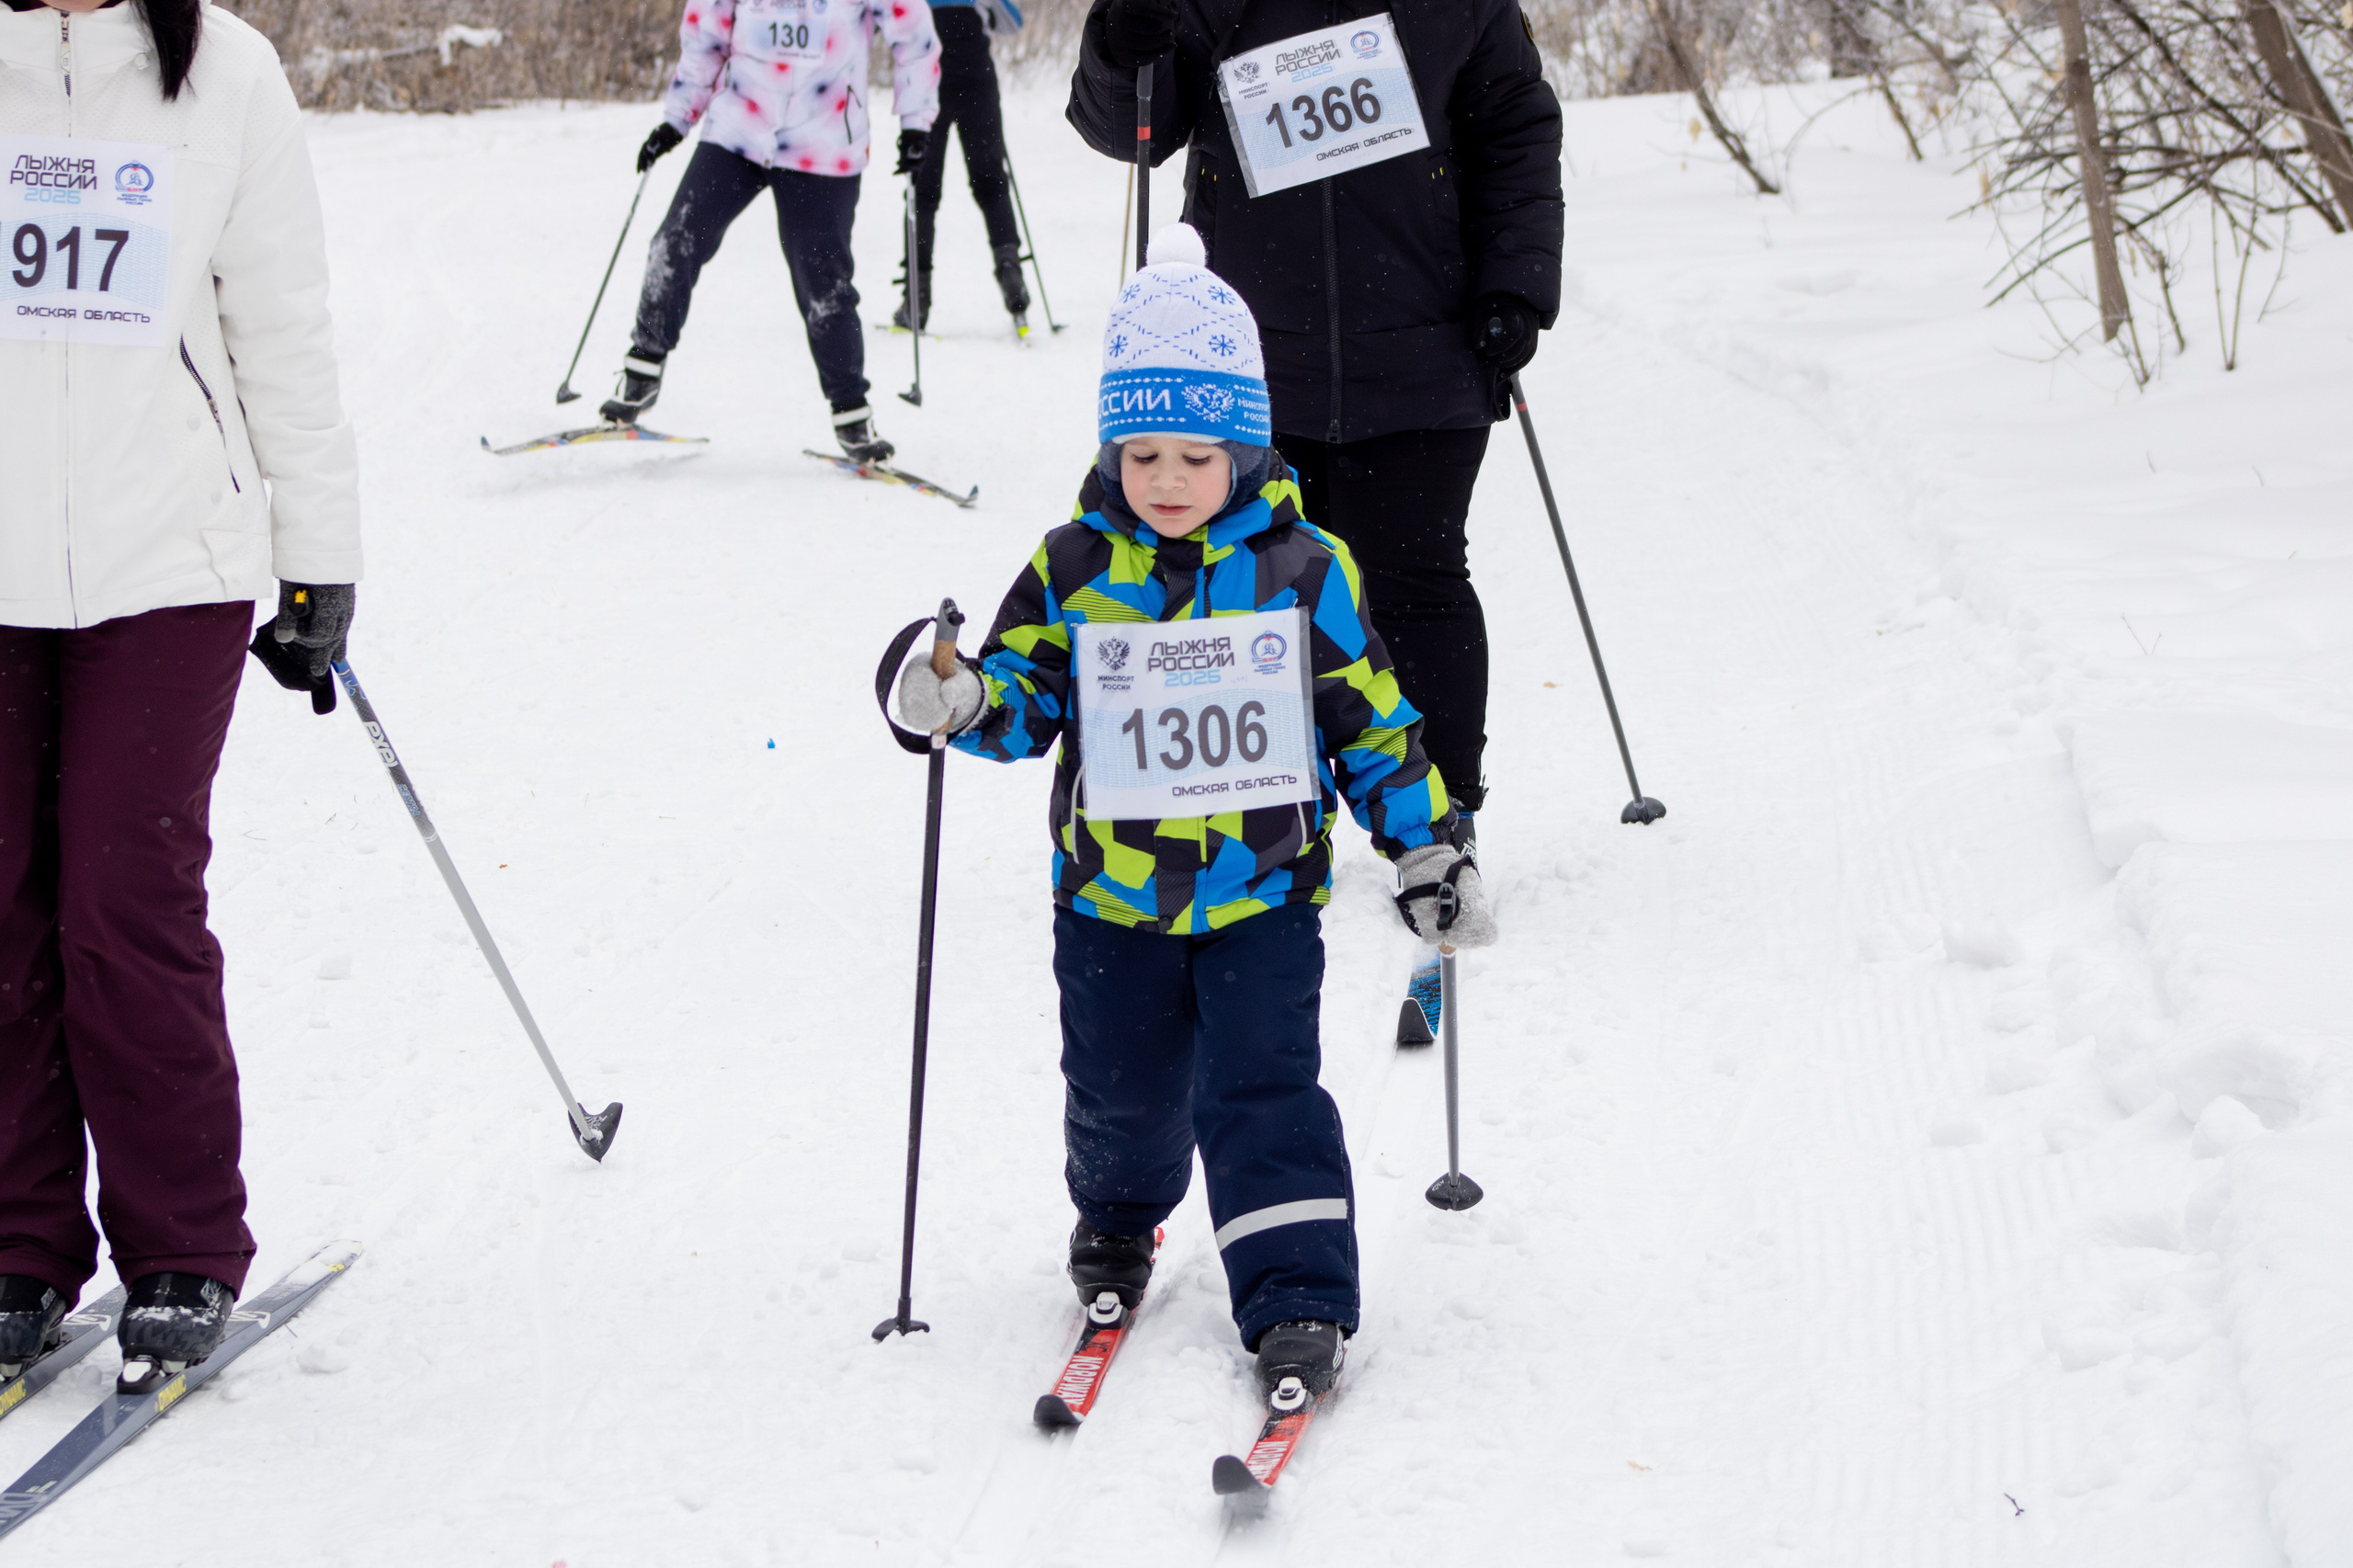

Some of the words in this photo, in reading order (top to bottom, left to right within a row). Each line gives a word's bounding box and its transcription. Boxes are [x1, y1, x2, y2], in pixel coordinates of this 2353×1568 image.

[768, 22, 809, 49] 130
[1275, 40, 1335, 64] ЛЫЖНЯ
[1275, 49, 1341, 75] РОССИИ
[1291, 62, 1334, 83] 2025
[1244, 89, 1267, 99] РОССИИ
[1266, 77, 1381, 148] 1366
[1316, 142, 1360, 162] ОМСКАЯ
[1363, 128, 1413, 147] ОБЛАСТЬ
[15, 154, 95, 174] ЛЫЖНЯ
[10, 170, 97, 190] РОССИИ
[24, 187, 81, 205] 2025
[0, 222, 130, 292] 917
[17, 305, 77, 319] ОМСКАЯ
[84, 309, 151, 323] ОБЛАСТЬ
[1098, 389, 1171, 420] ССИИ
[1150, 637, 1231, 656] ЛЫЖНЯ
[1148, 652, 1234, 672] РОССИИ
[1165, 669, 1221, 687] 2025
[1122, 700, 1267, 770] 1306
[1172, 782, 1229, 797] ОМСКАЯ
[1235, 774, 1297, 790] ОБЛАСТЬ
